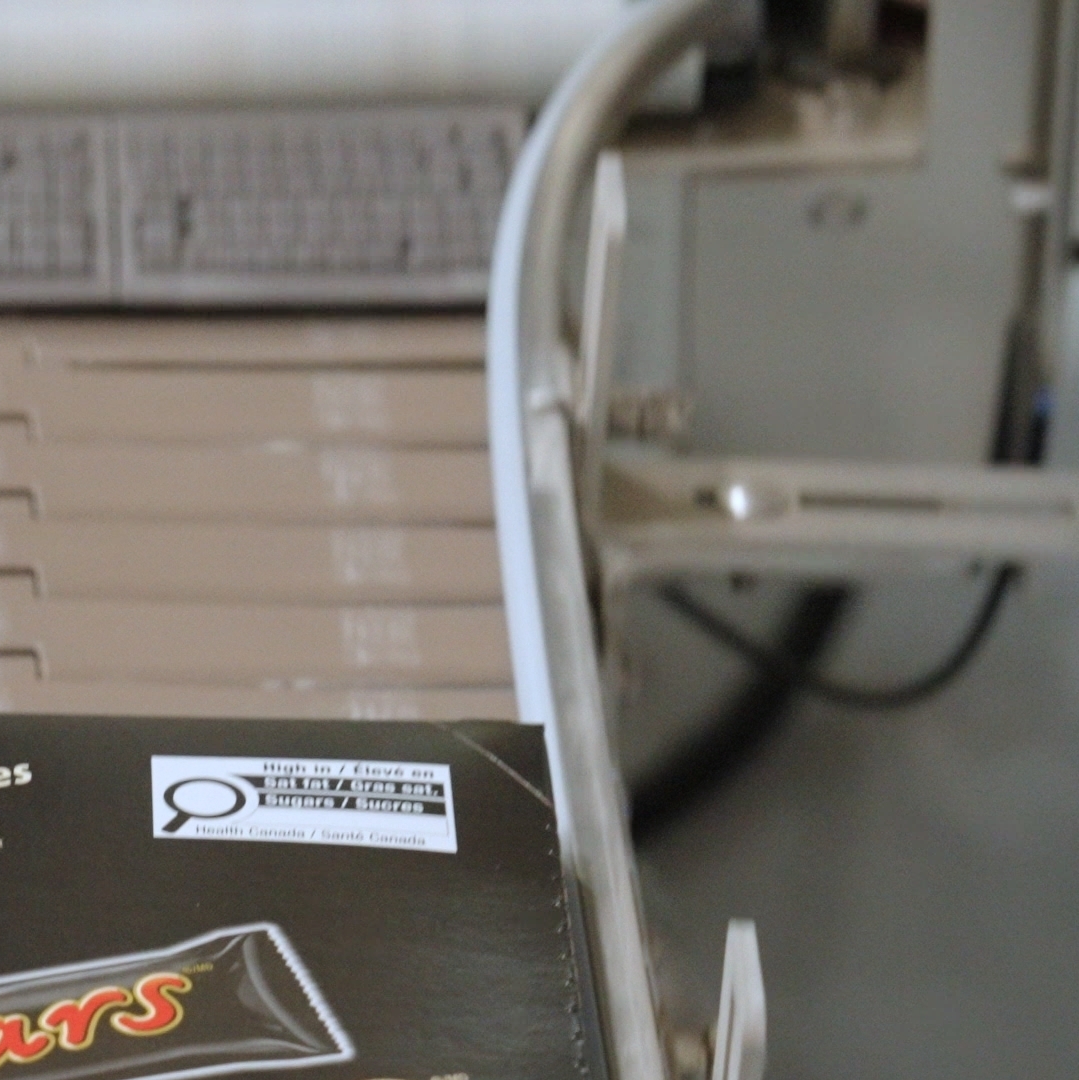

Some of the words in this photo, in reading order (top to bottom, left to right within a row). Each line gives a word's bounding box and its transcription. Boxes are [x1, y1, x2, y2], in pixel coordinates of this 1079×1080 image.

[263, 762, 307, 777] High
[314, 763, 331, 774] in
[411, 769, 434, 779] en
[264, 776, 298, 791] Sat
[301, 777, 331, 791] fat
[350, 780, 396, 795] Gras
[264, 792, 335, 810] Sugars
[355, 796, 425, 814] Sucres
[196, 823, 244, 837] Health
[249, 825, 305, 840] Canada
[321, 827, 364, 843] Santé
[369, 830, 426, 847] Canada
